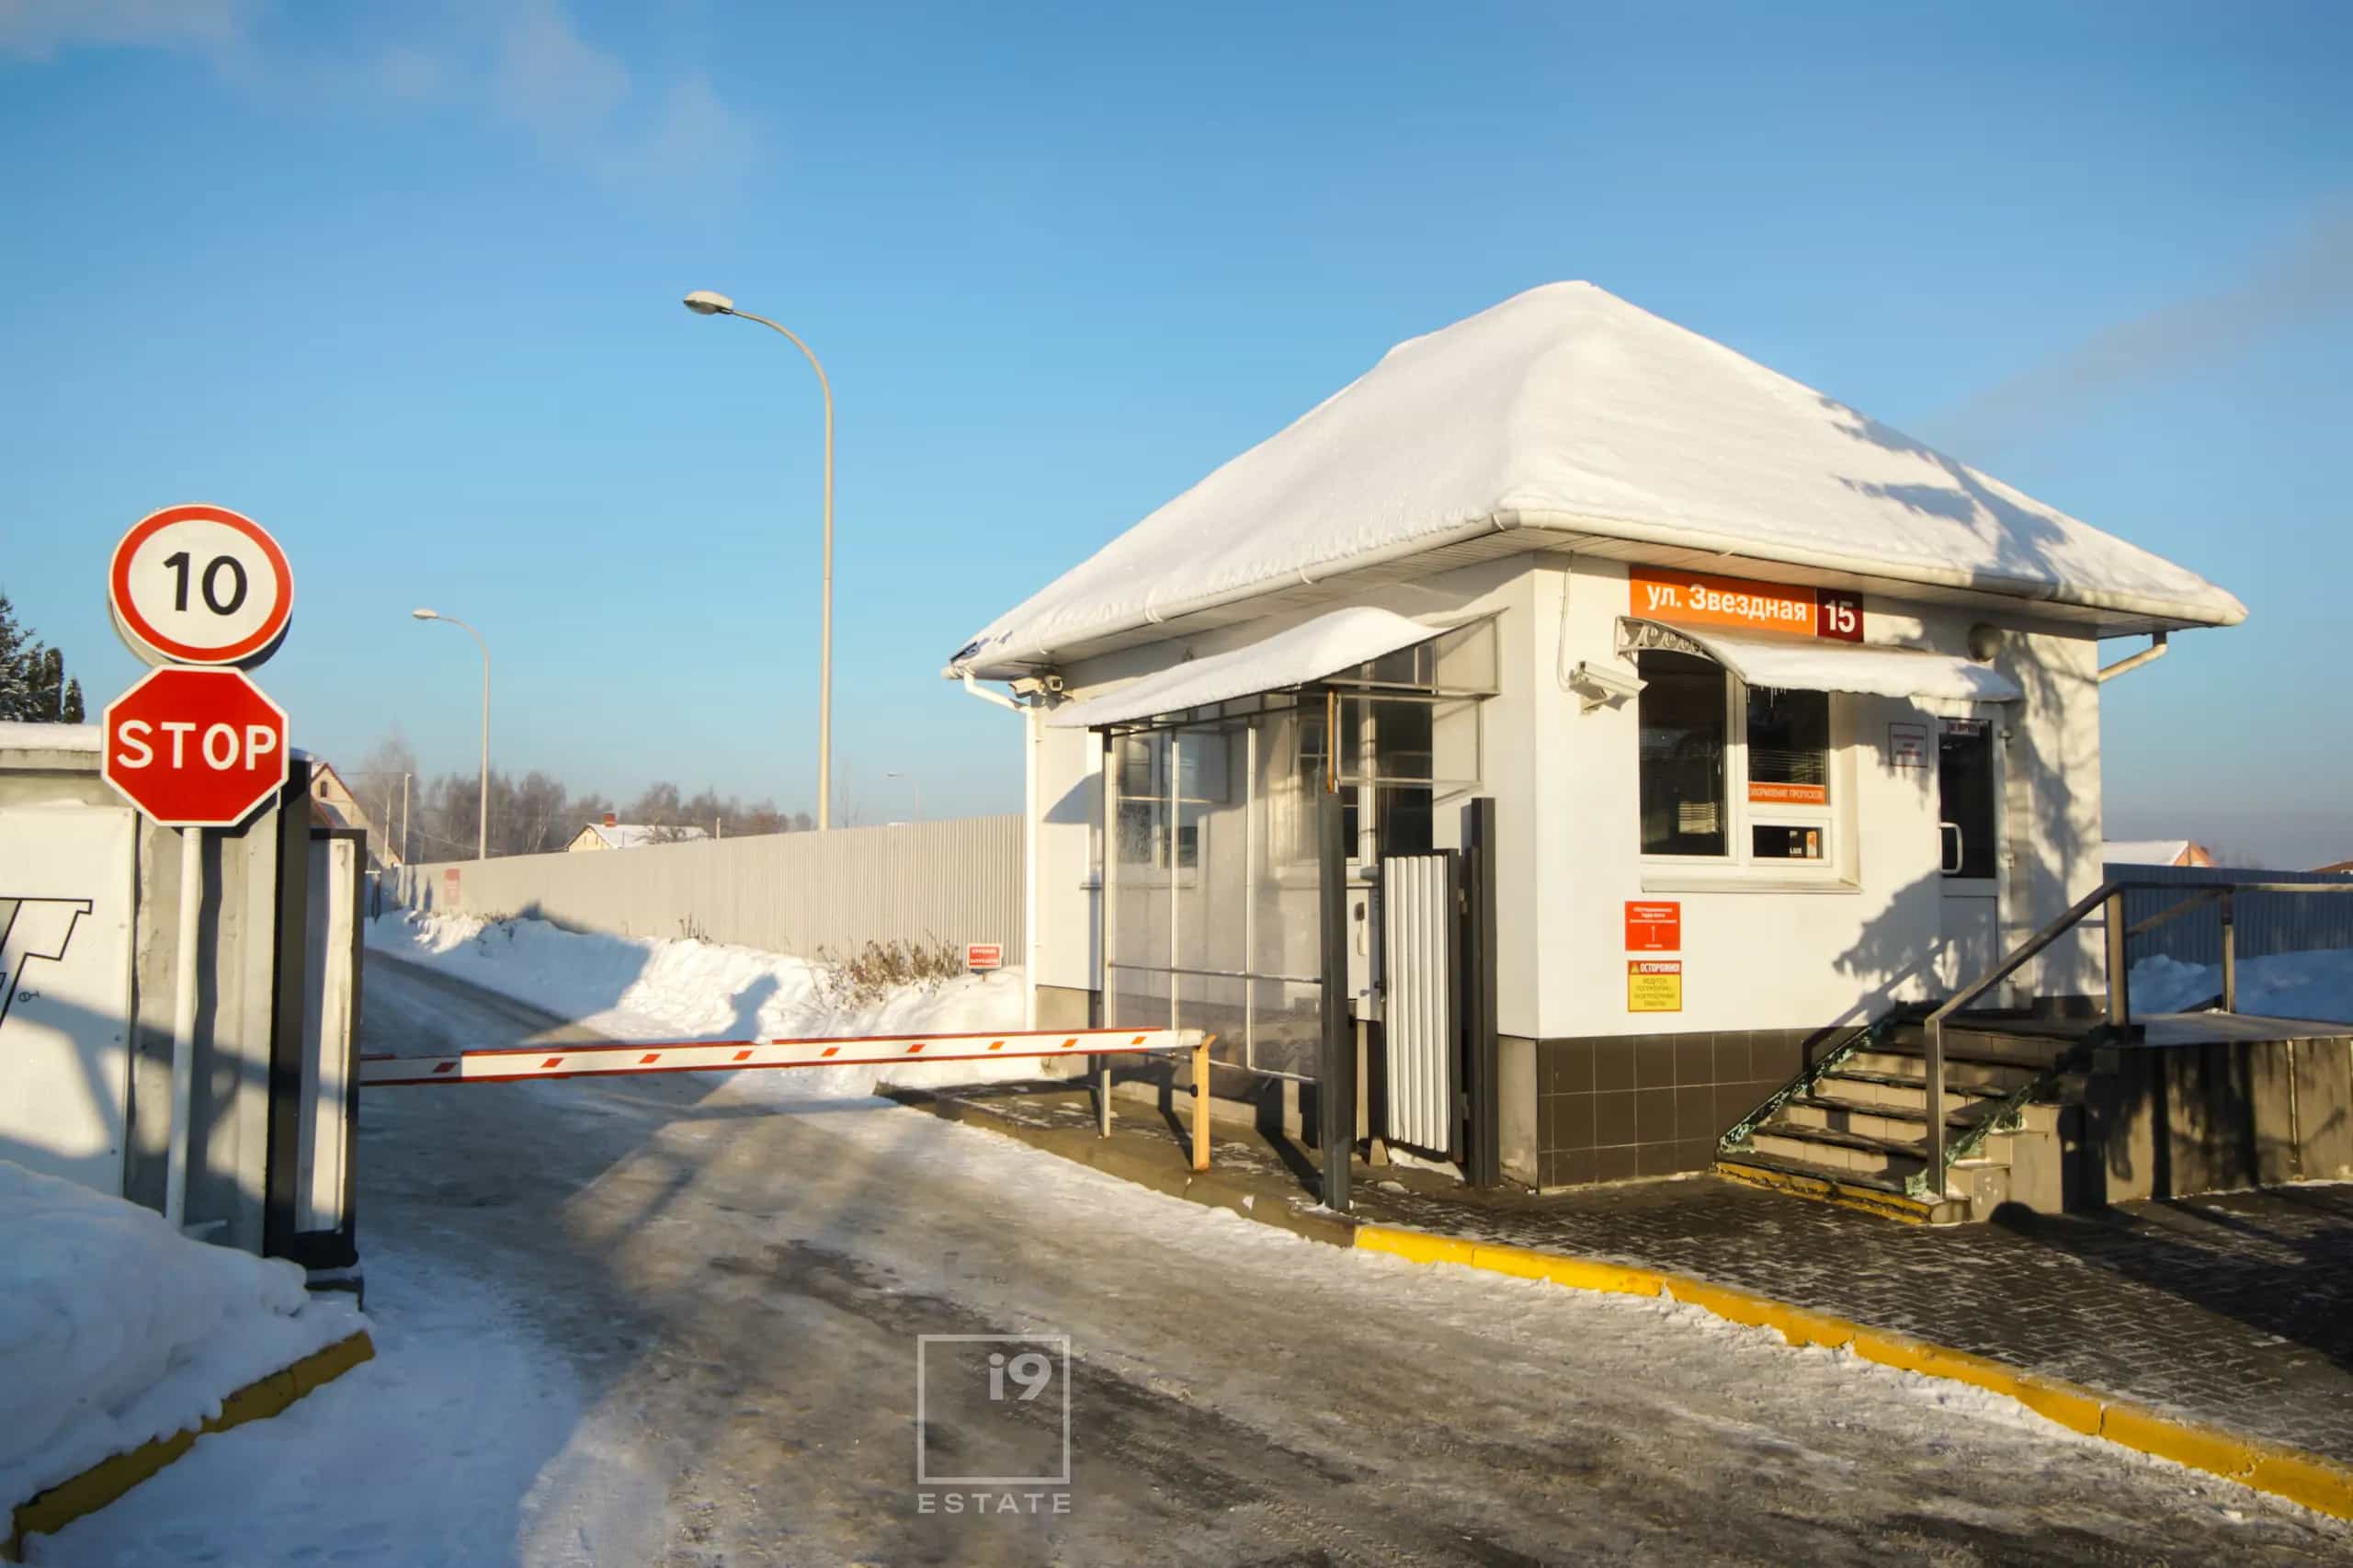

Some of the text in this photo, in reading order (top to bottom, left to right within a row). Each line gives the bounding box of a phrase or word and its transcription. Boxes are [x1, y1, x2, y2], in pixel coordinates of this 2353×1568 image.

[163, 551, 247, 616] 10
[1646, 584, 1808, 622] ул. Звездная
[1824, 599, 1856, 633] 15
[117, 719, 278, 771] STOP
